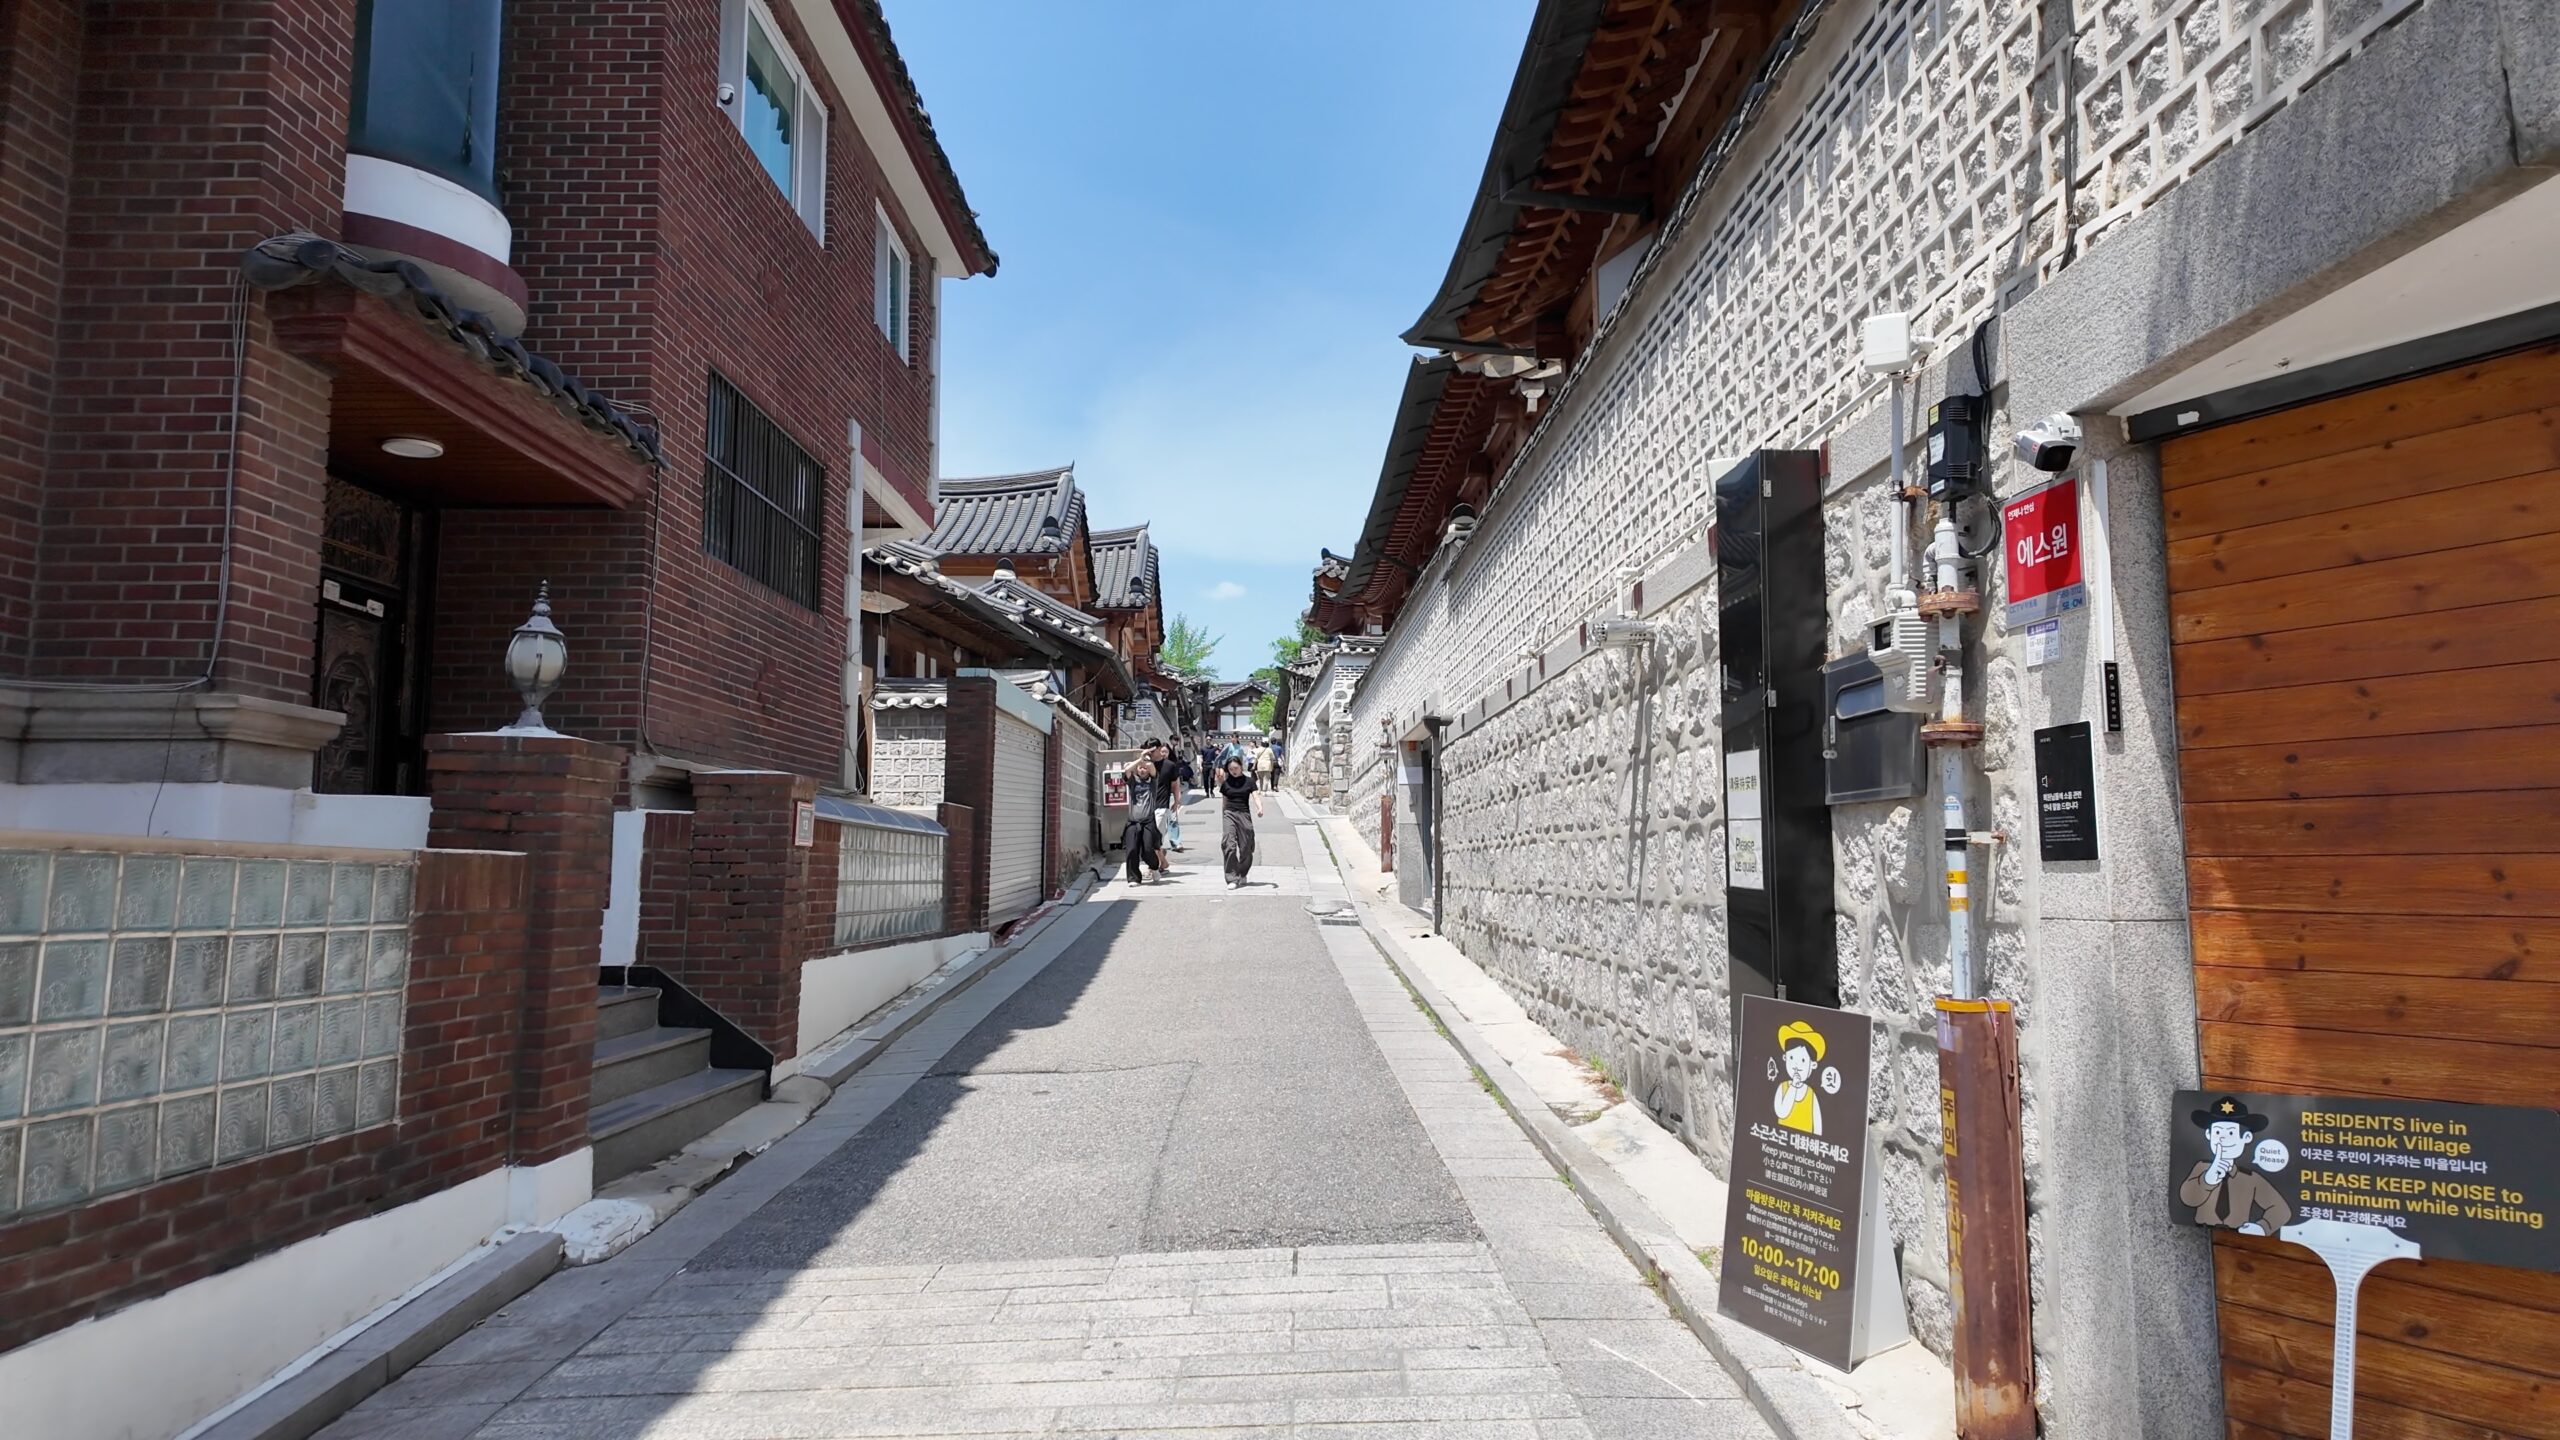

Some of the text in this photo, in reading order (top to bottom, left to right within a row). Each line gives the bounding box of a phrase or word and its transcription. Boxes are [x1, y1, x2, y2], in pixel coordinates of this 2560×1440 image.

[2008, 502, 2035, 520] 언제나 안심
[2017, 523, 2068, 568] 에스원
[1735, 837, 1755, 851] Please
[1943, 1097, 1955, 1151] 주의
[2301, 1111, 2467, 1136] RESIDENTS live in
[1750, 1122, 1849, 1163] 소곤소곤 대화해주세요
[2260, 1146, 2281, 1155] Quiet
[2301, 1129, 2471, 1157] this Hanok Village
[1761, 1143, 1836, 1174] Keep your voices down
[1763, 1156, 1832, 1184] 小さな声で話して下さい
[2259, 1156, 2285, 1164] Please
[2301, 1148, 2488, 1174] 이곳은 주민이 거주하는 마을입니다
[2301, 1170, 2524, 1204] PLEASE KEEP NOISE to
[1746, 1189, 1841, 1231] 마을방문시간 꼭 지켜주세요
[1750, 1203, 1835, 1241] Please respect the visiting hours
[2300, 1189, 2543, 1229] a minimum while visiting
[2300, 1206, 2407, 1228] 조용히 구경해주세요
[1753, 1264, 1822, 1301] 일요일은 골목길 쉬는날
[1762, 1284, 1780, 1296] Closed
[1787, 1293, 1808, 1309] Sundays
